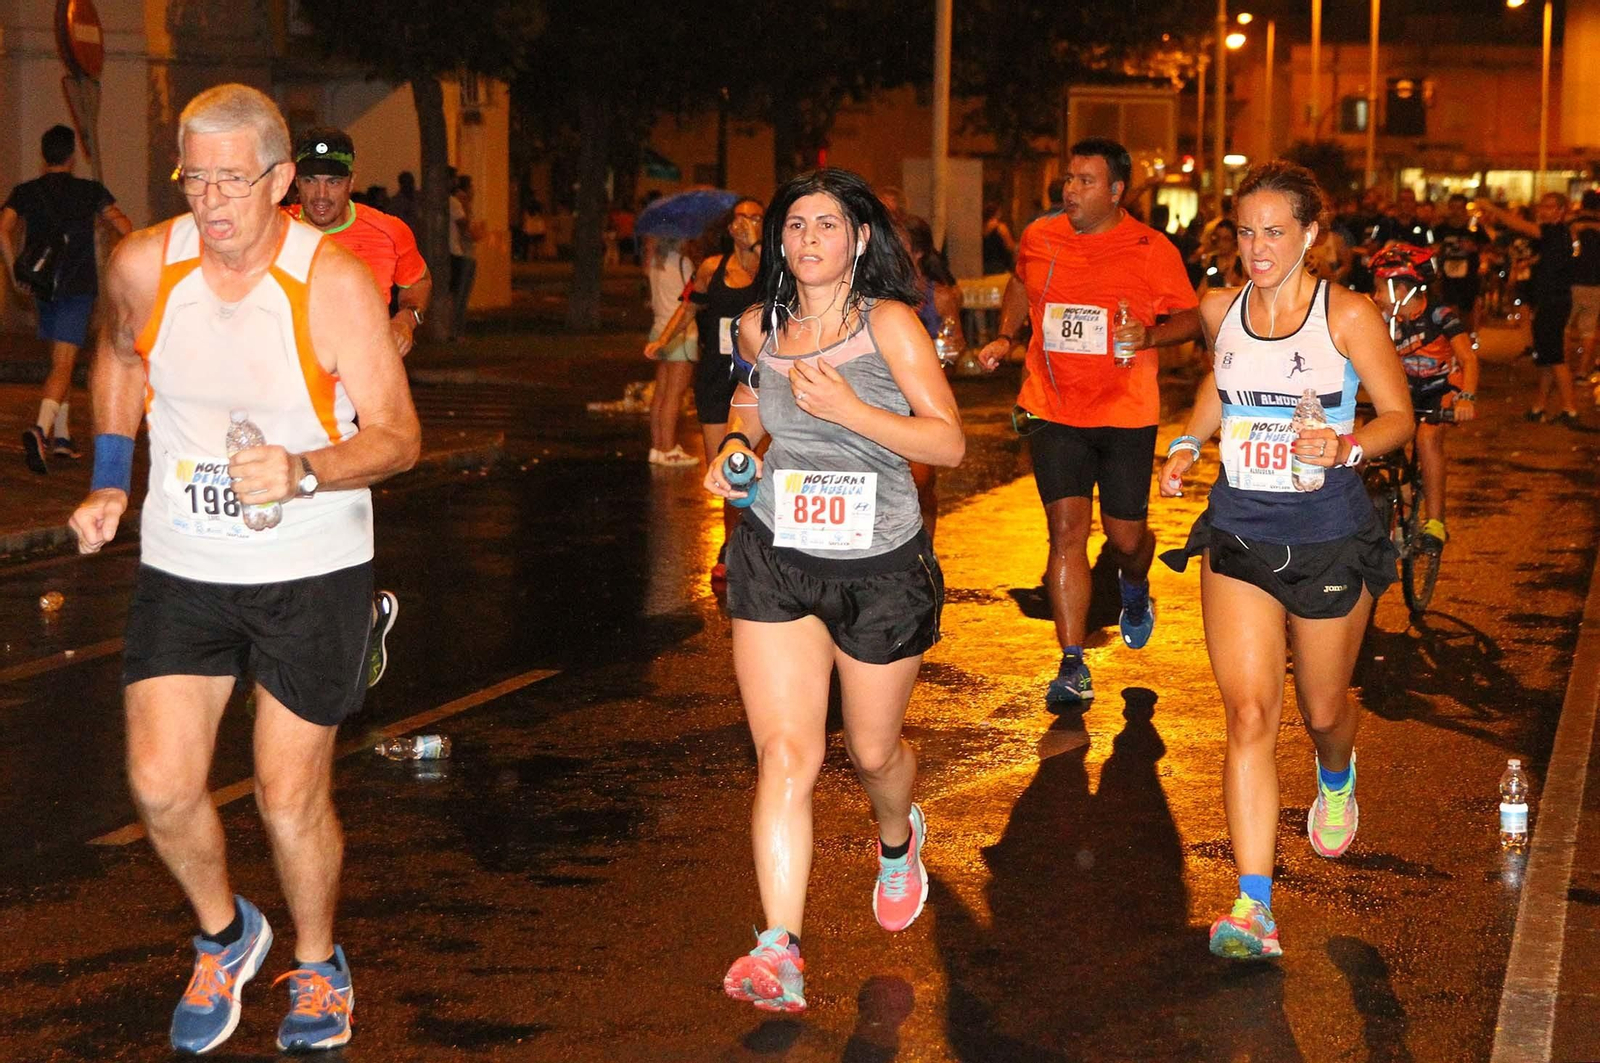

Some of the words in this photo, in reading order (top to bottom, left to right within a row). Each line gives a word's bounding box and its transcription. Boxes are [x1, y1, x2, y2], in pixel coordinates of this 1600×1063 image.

[1061, 320, 1083, 339] 84
[1261, 394, 1320, 406] ALMUD
[1251, 422, 1296, 433] NOCTUR
[1249, 432, 1262, 441] DE
[1264, 432, 1297, 443] HUELV
[1239, 441, 1288, 470] 169
[194, 463, 229, 475] NOCT
[192, 473, 209, 484] DE
[803, 474, 866, 486] NOCTURNA
[801, 484, 816, 494] DE
[819, 485, 863, 495] HUELVA
[184, 484, 240, 518] 198
[794, 495, 845, 525] 820
